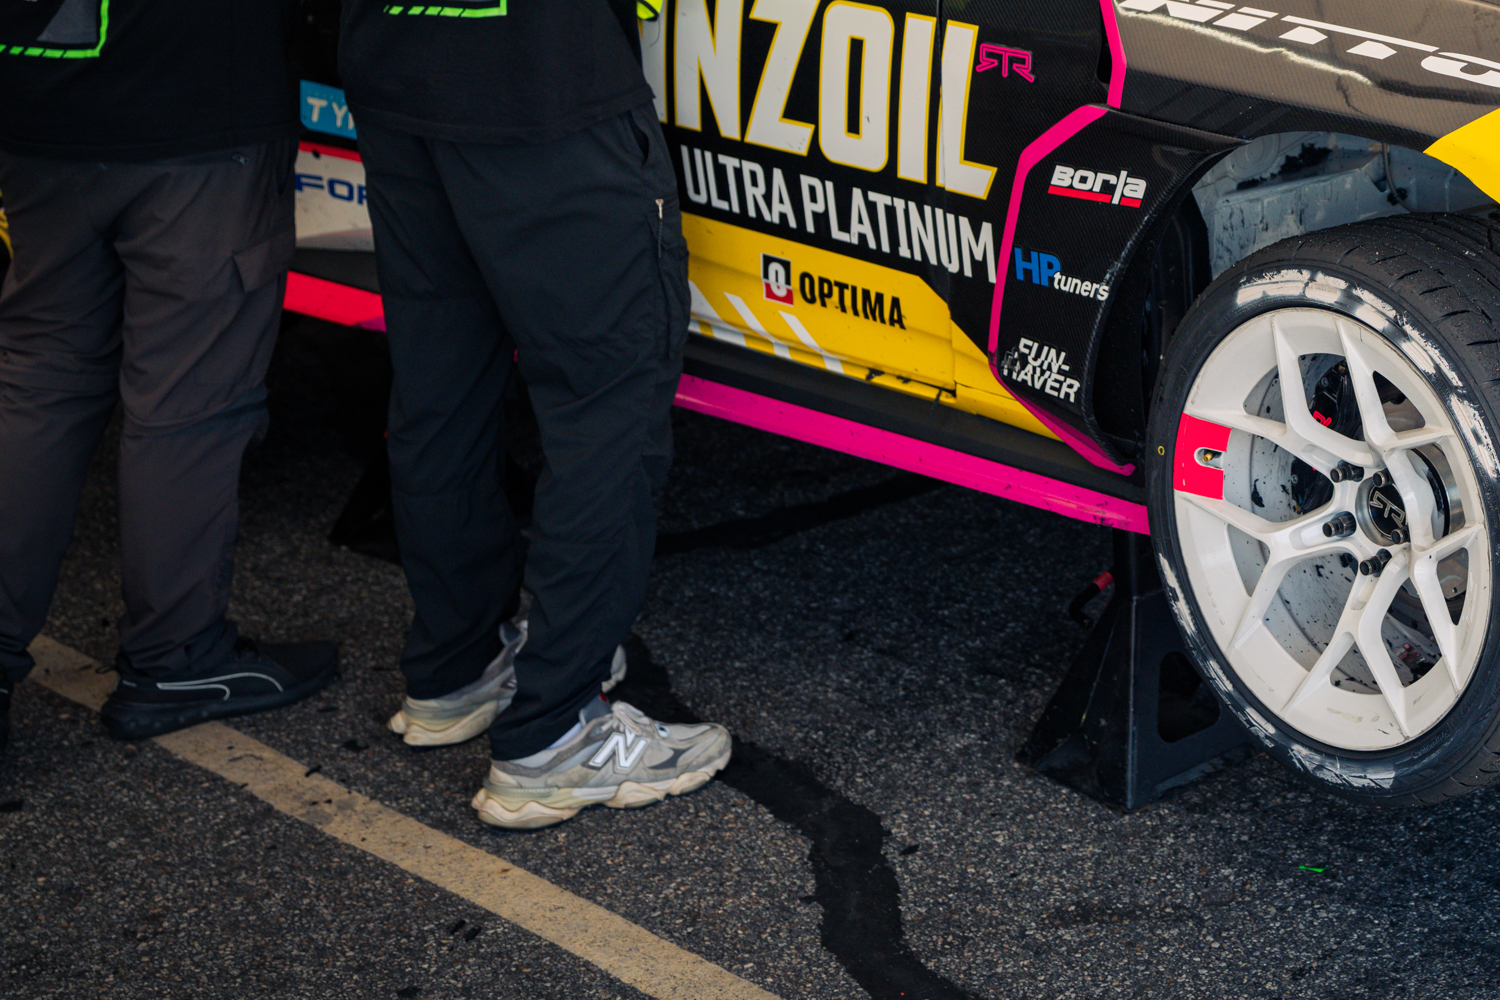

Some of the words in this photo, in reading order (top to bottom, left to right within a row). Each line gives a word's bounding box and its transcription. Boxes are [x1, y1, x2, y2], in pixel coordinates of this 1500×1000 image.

[976, 43, 1036, 83] RTR
[680, 143, 797, 231] ULTRA
[799, 173, 998, 285] PLATINUM
[799, 270, 907, 331] OPTIMA
[1018, 336, 1071, 374] FUN-
